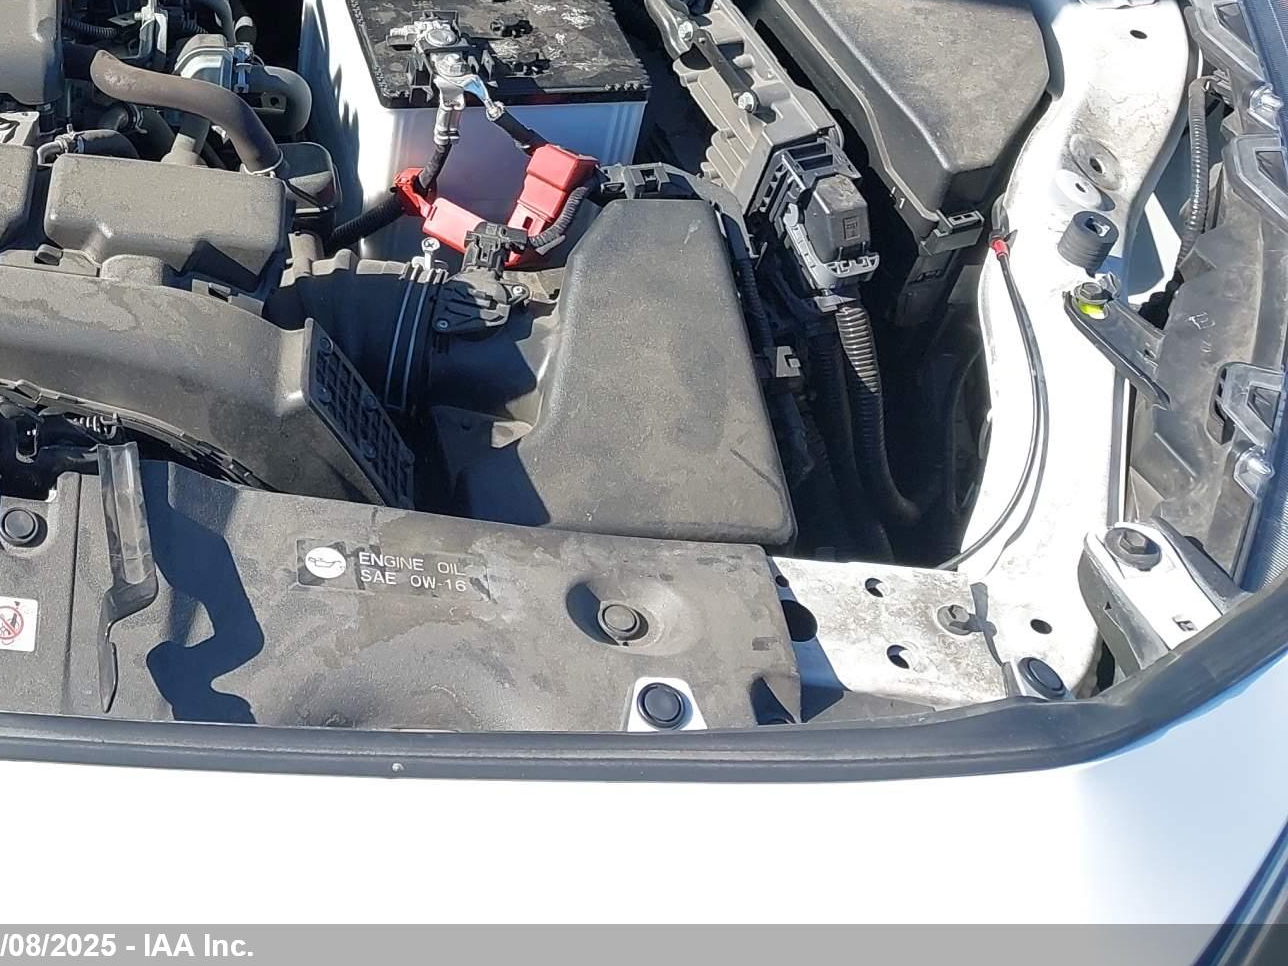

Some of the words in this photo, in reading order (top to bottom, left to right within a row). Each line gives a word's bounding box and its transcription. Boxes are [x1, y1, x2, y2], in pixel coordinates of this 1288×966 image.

[358, 551, 425, 572] ENGINE
[437, 560, 465, 576] OIL
[360, 569, 397, 585] SAE
